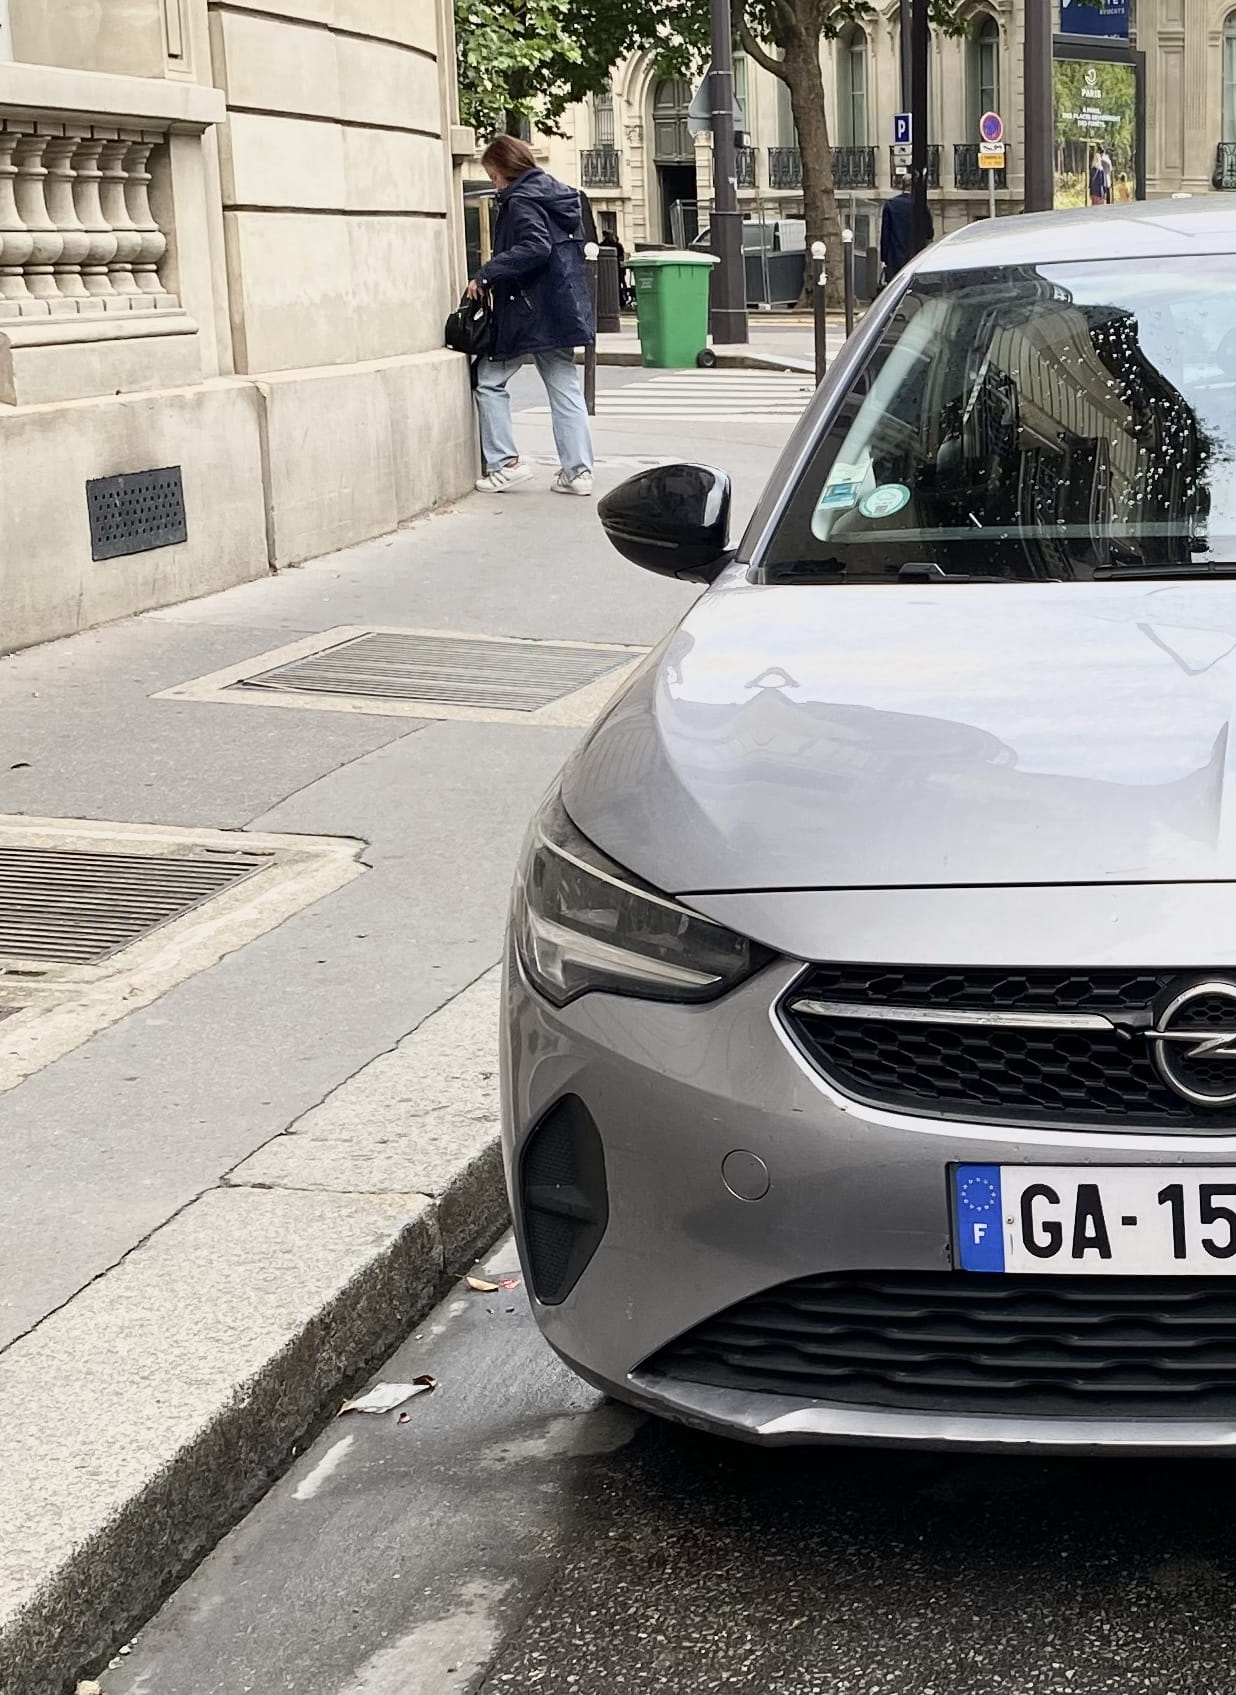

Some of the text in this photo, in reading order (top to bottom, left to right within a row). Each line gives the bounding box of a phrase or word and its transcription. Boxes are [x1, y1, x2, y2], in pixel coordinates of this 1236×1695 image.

[1081, 89, 1101, 98] PARIS
[897, 119, 906, 139] P
[973, 1223, 988, 1244] F
